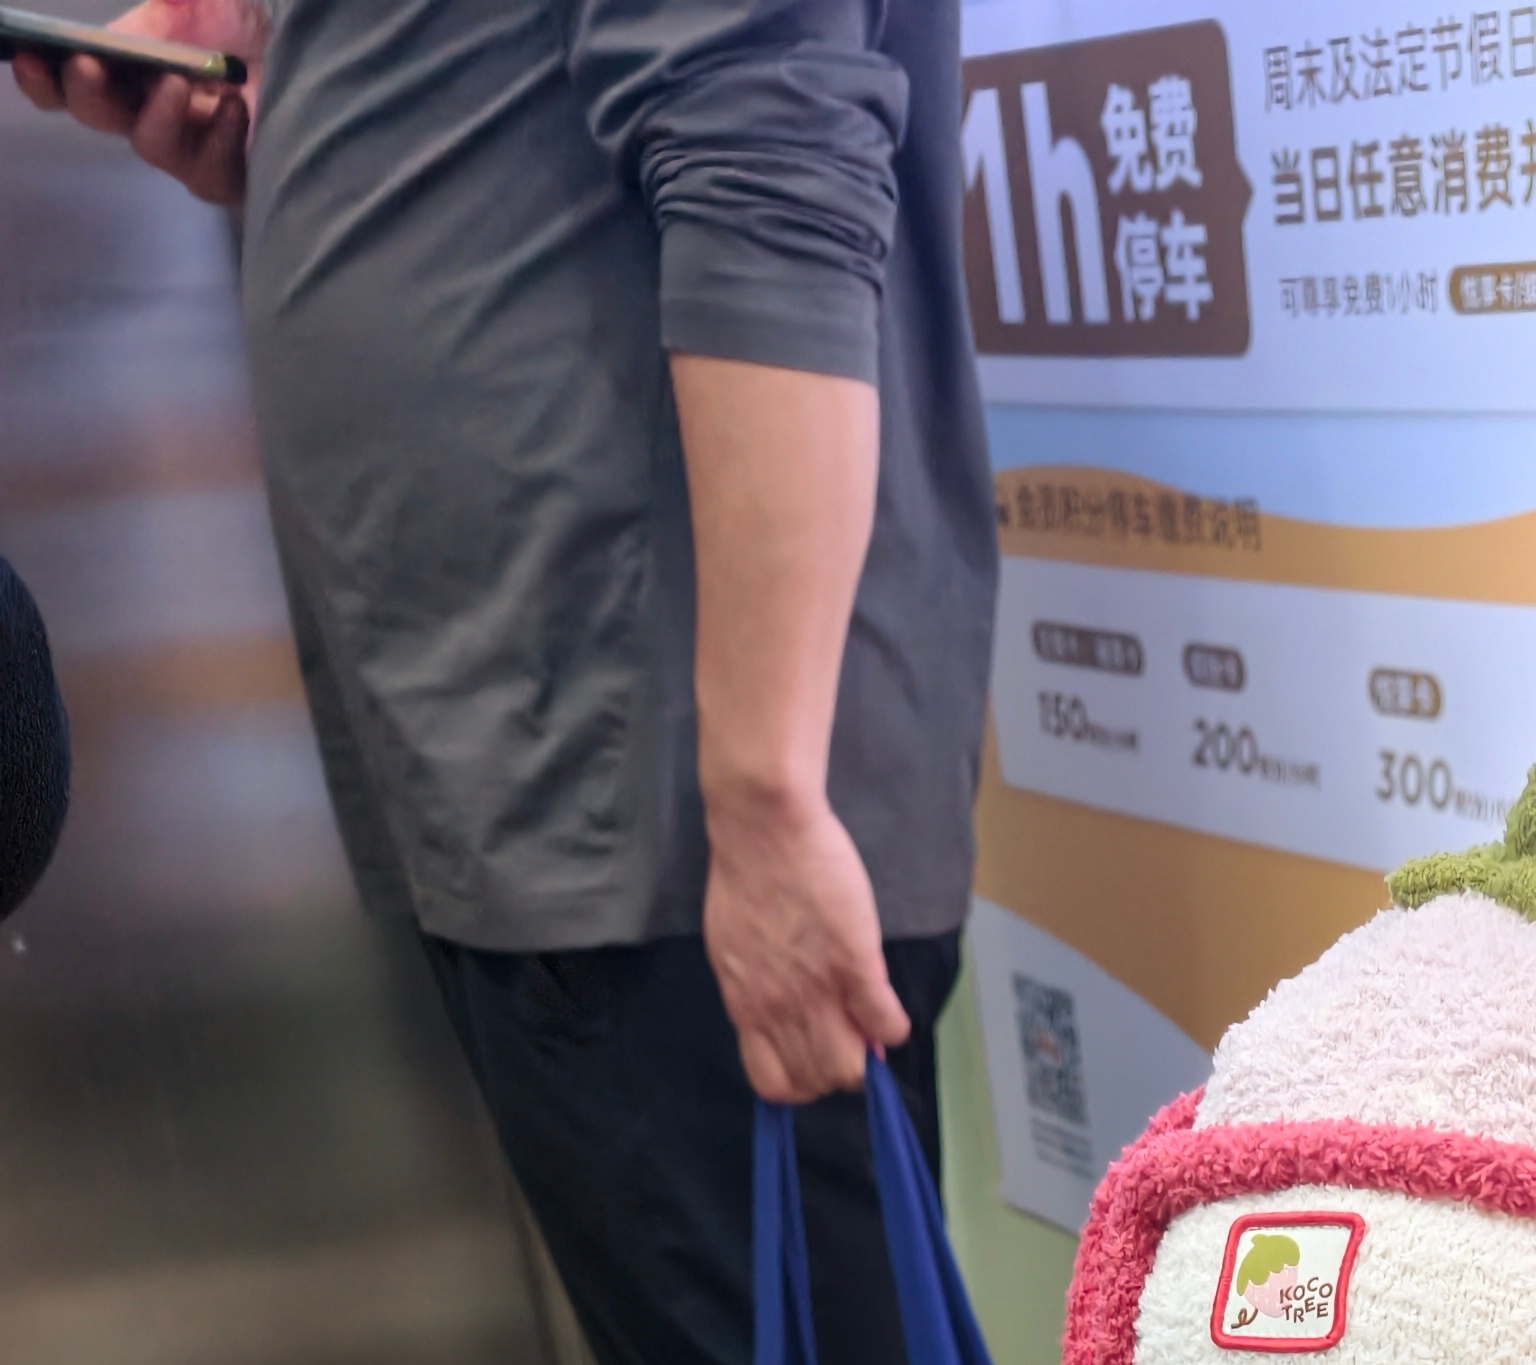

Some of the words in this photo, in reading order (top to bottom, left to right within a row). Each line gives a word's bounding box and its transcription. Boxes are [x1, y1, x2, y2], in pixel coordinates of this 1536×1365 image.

[1264, 6, 1536, 111] 周末及法定节假日
[1101, 73, 1203, 196] 免费
[960, 80, 1111, 325] 1h
[1113, 207, 1214, 322] 停车
[1279, 1276, 1333, 1304] KOCO
[1282, 1296, 1329, 1324] TREE
